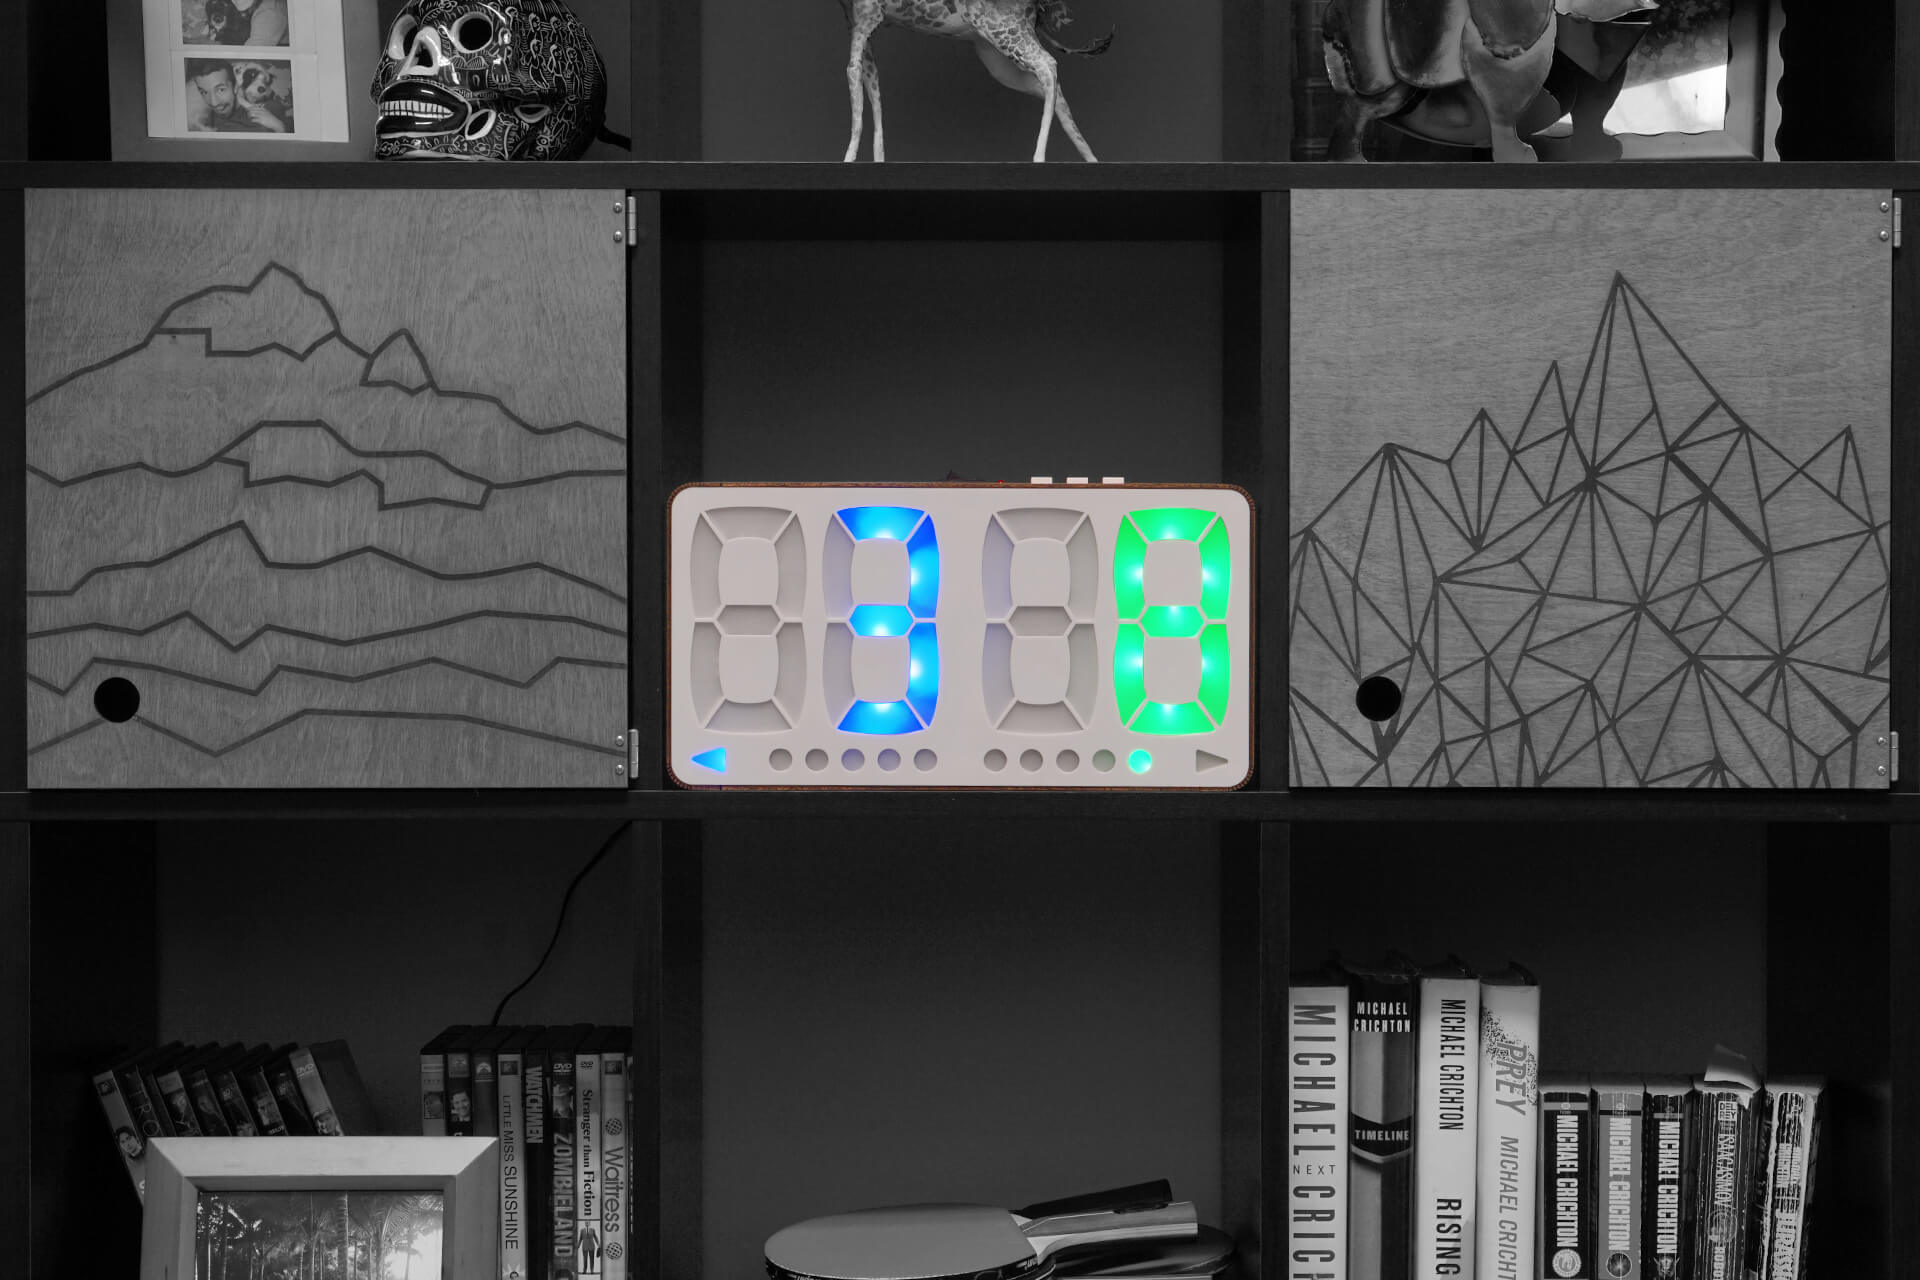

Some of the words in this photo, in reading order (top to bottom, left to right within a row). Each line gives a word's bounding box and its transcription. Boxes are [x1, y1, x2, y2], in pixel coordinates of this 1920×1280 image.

[836, 506, 940, 735] 3
[1113, 507, 1231, 735] 8
[1354, 1019, 1410, 1033] CRICHTON
[1357, 1002, 1408, 1015] MICHAEL
[1440, 999, 1466, 1058] MICHAEL
[526, 1066, 544, 1143] WATCHMEN
[1293, 1004, 1336, 1156] MICHAEL
[1439, 1065, 1465, 1131] CRICHTON
[1495, 1041, 1527, 1116] PREY
[1719, 1102, 1736, 1111] DEL
[502, 1095, 512, 1128] LITTLE
[581, 1089, 594, 1142] Stranger
[1354, 1130, 1410, 1141] TIMELINE
[1719, 1111, 1736, 1120] REY
[503, 1131, 514, 1162] MISS
[583, 1144, 592, 1168] than
[1293, 1164, 1336, 1175] NEXT
[1556, 1115, 1578, 1174] MICHAEL
[1609, 1118, 1631, 1177] MICHAEL
[1658, 1121, 1680, 1180] MICHAEL
[1716, 1134, 1735, 1165] ISAAC
[553, 1133, 574, 1257] ZOMBIELAND
[584, 1171, 594, 1216] Fiction
[604, 1146, 624, 1233] Waitress
[1500, 1136, 1518, 1214] MICHAEL
[1714, 1165, 1733, 1208] ASIMOV
[504, 1166, 518, 1249] SUNSHINE
[1435, 1198, 1463, 1275] RISING
[1556, 1178, 1578, 1247] CRICHTON
[1608, 1181, 1630, 1251] CRICHTON
[1656, 1184, 1678, 1253] CRICHTON
[1713, 1246, 1726, 1280] ROBO
